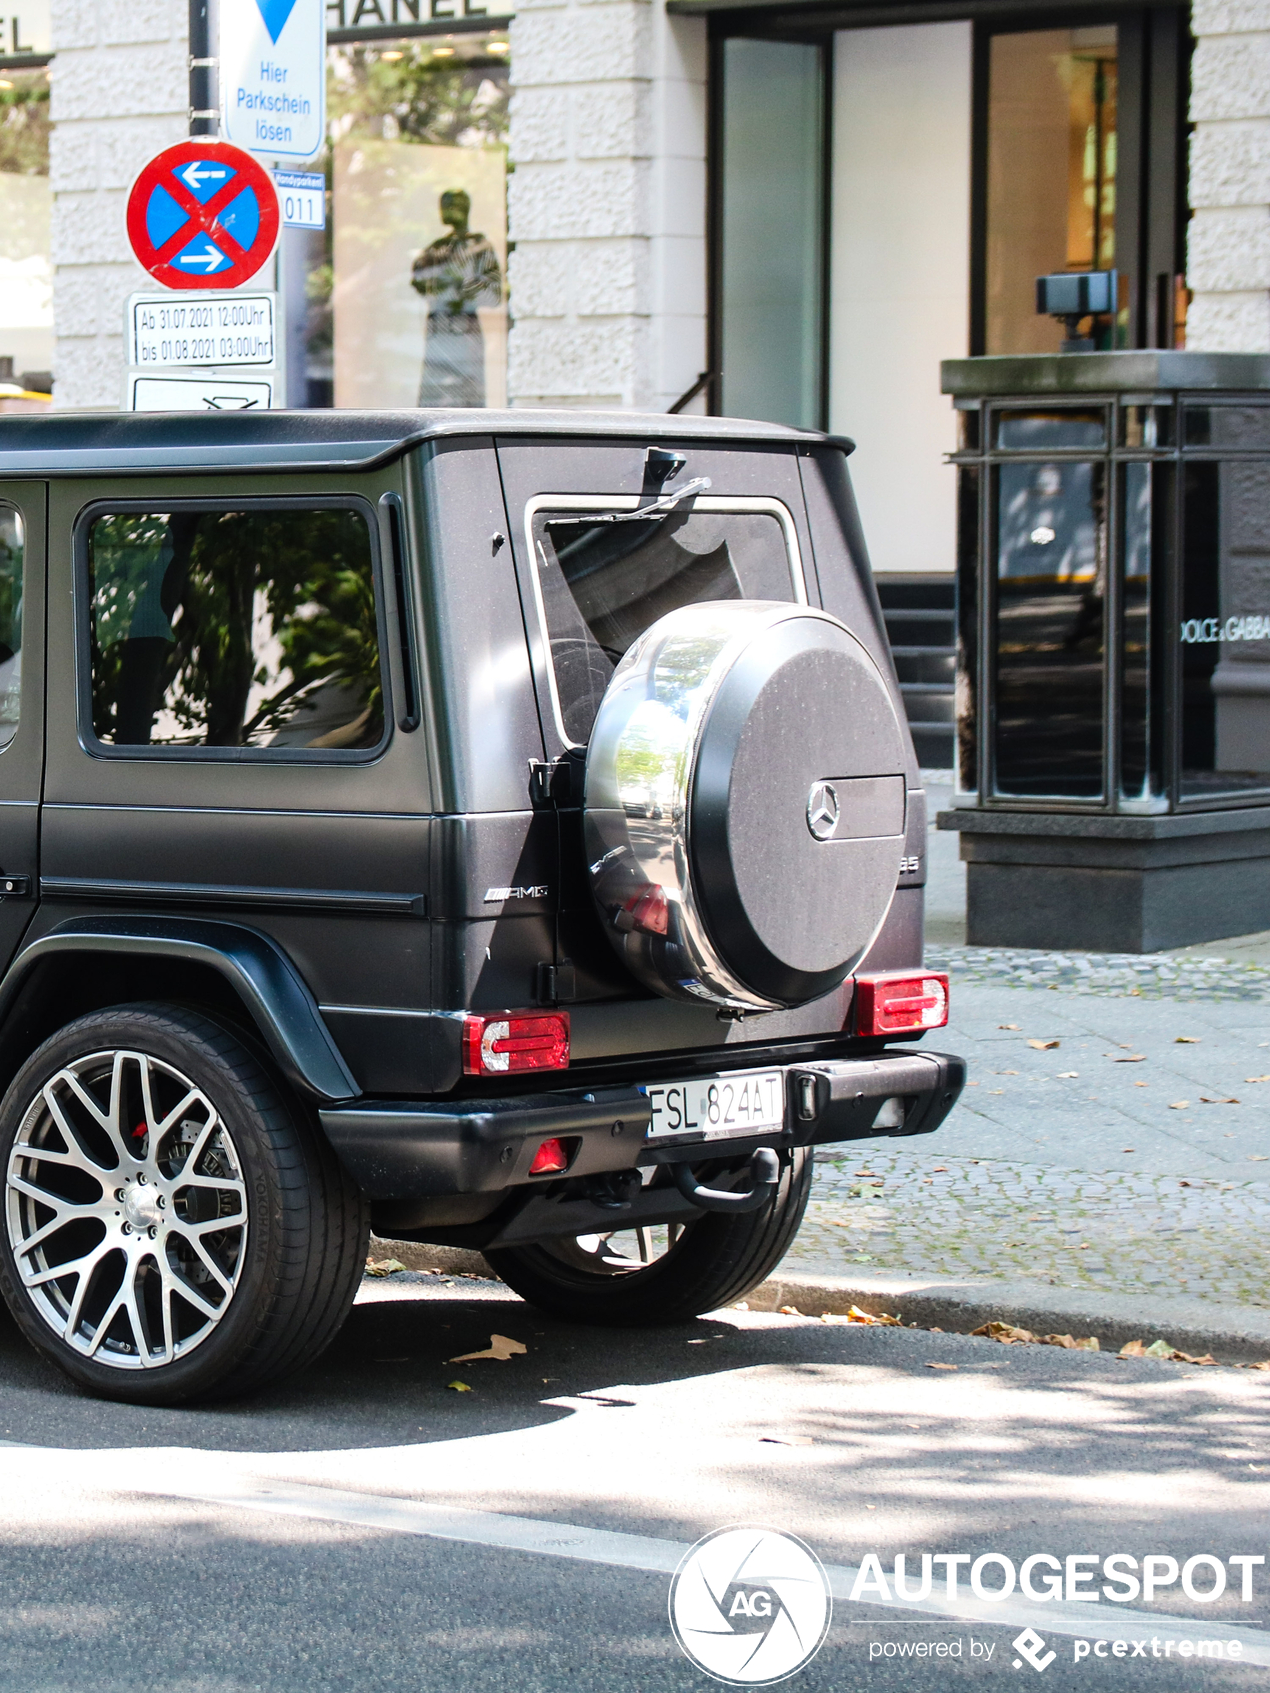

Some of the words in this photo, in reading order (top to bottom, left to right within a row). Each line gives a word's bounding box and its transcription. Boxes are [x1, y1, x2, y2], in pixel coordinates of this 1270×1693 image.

[327, 0, 487, 27] HANEL
[260, 61, 288, 82] Hier
[237, 87, 311, 114] Parkschein
[256, 119, 292, 141] lösen
[141, 309, 156, 330] Ab
[160, 307, 214, 329] 31.07.2021
[142, 340, 157, 361] bis
[161, 338, 216, 360] 01.08.2021
[509, 885, 548, 898] AMG
[649, 1086, 698, 1132] FSL
[707, 1078, 777, 1124] 824AT
[255, 1172, 269, 1262] YOKOHAMA
